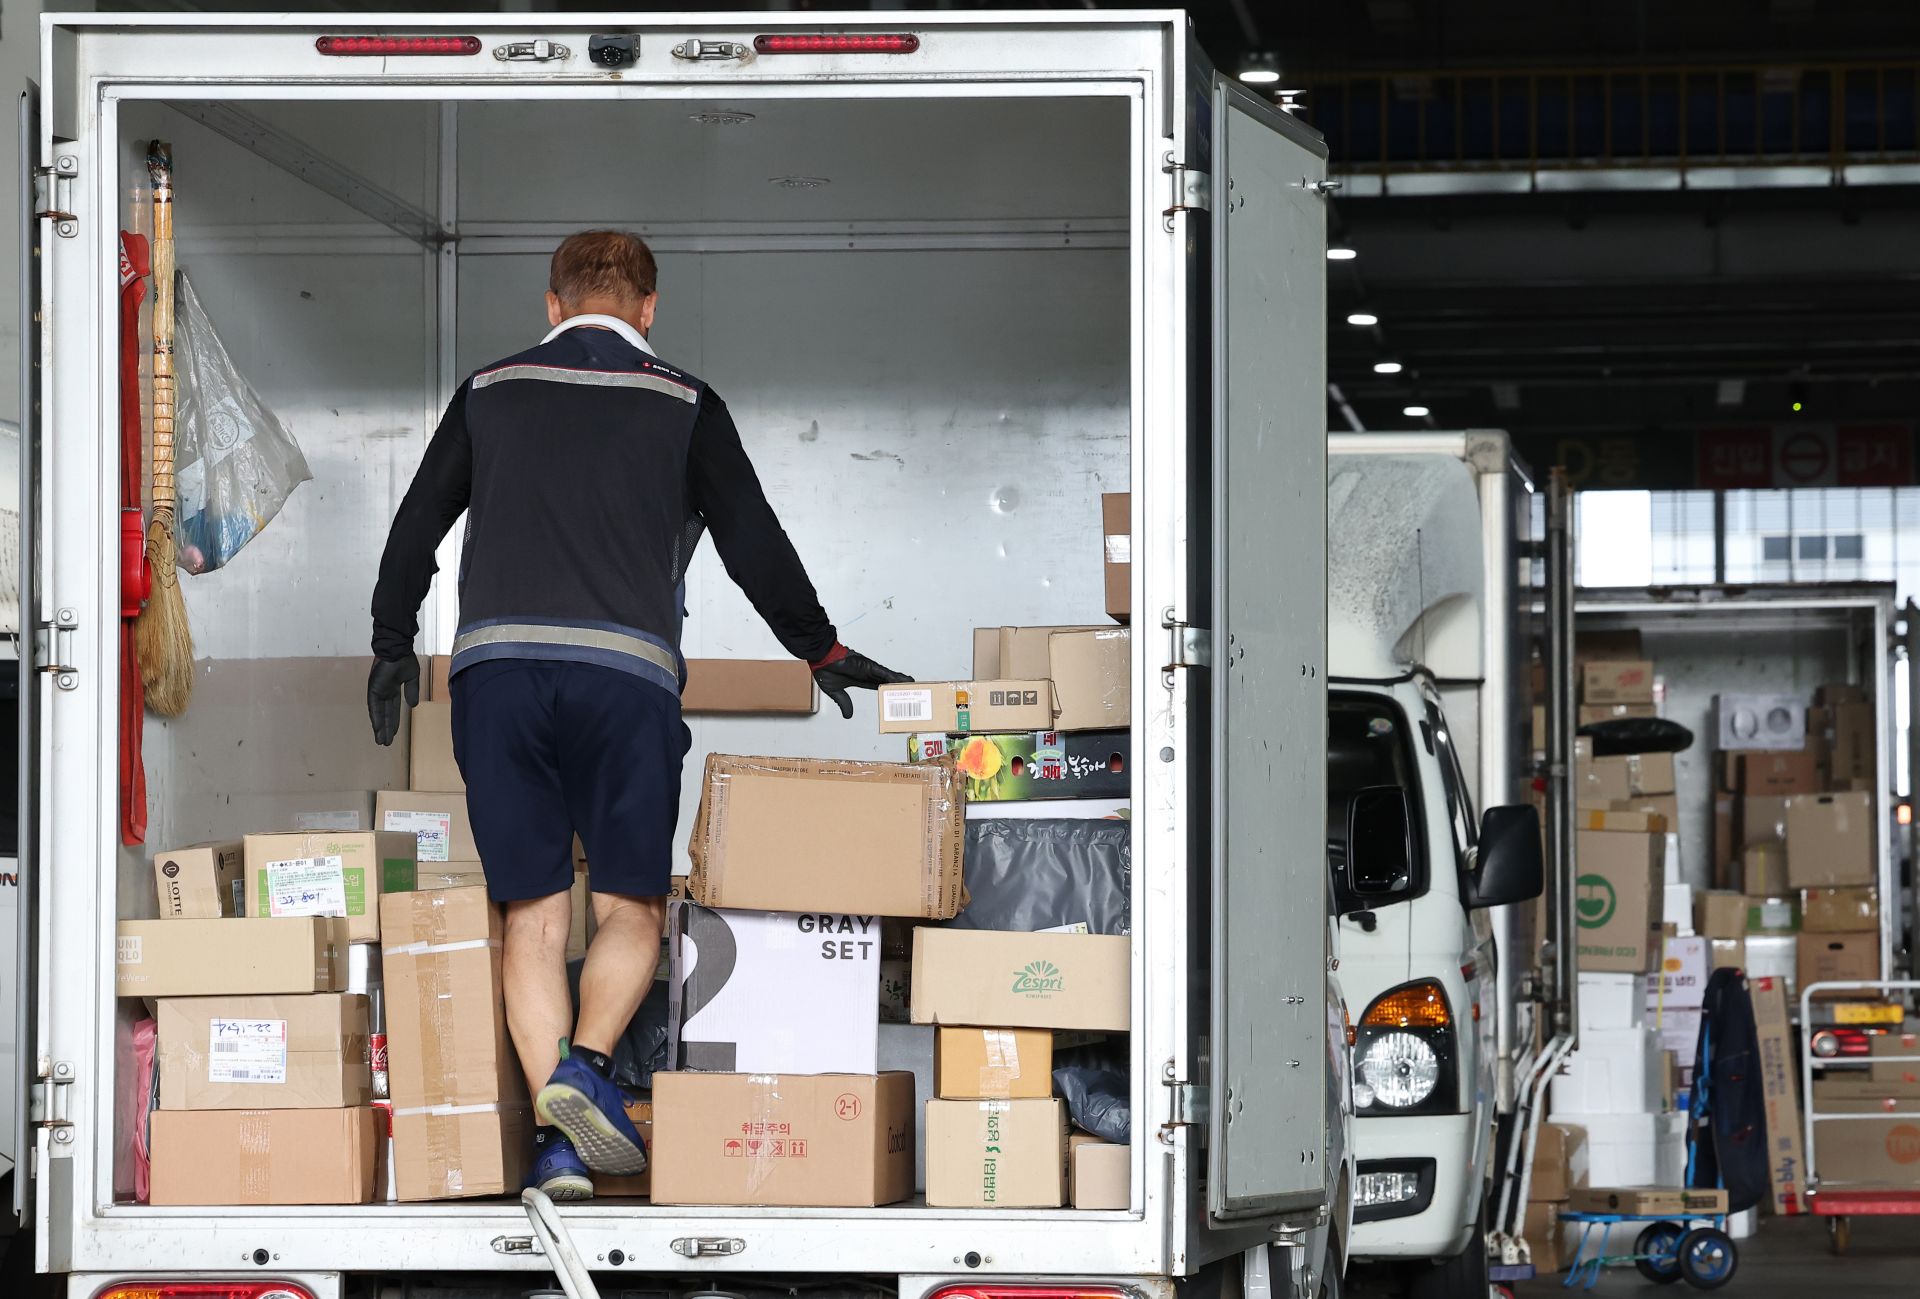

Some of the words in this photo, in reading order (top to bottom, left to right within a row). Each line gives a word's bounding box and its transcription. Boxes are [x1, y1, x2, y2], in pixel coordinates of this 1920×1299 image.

[1068, 754, 1106, 780] 복숭아
[171, 880, 183, 916] LOTTE
[797, 914, 874, 934] GRAY
[821, 941, 873, 960] SET
[1012, 971, 1064, 993] Zespri
[839, 1099, 858, 1116] 2-1
[742, 1122, 791, 1136] 취급주의
